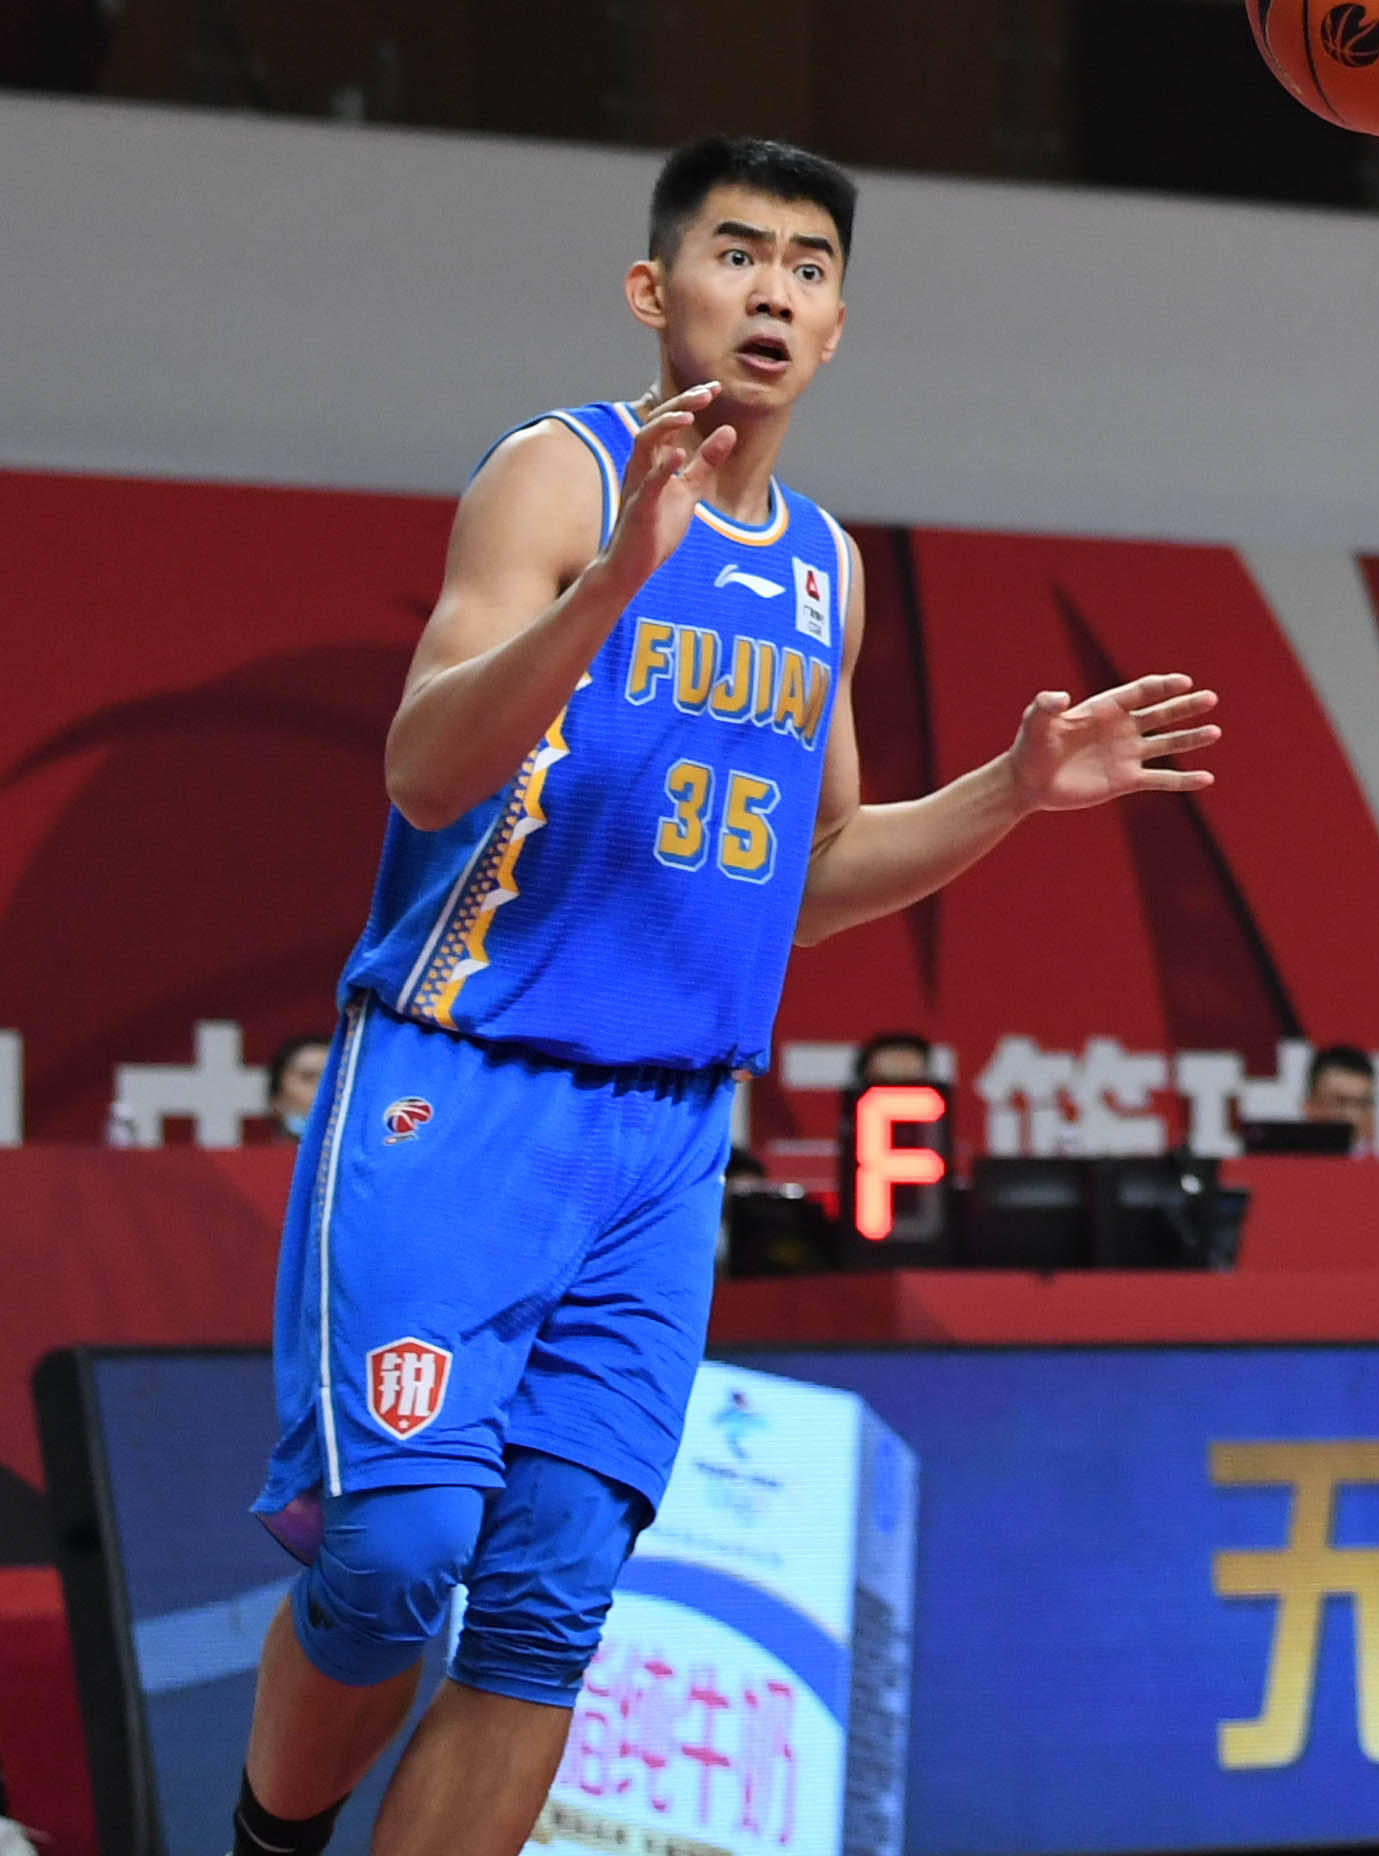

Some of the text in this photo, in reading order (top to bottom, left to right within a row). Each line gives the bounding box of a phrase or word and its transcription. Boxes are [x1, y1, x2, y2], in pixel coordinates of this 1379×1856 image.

[625, 617, 831, 752] FUJIAN
[653, 757, 781, 885] 35
[855, 1086, 946, 1241] F
